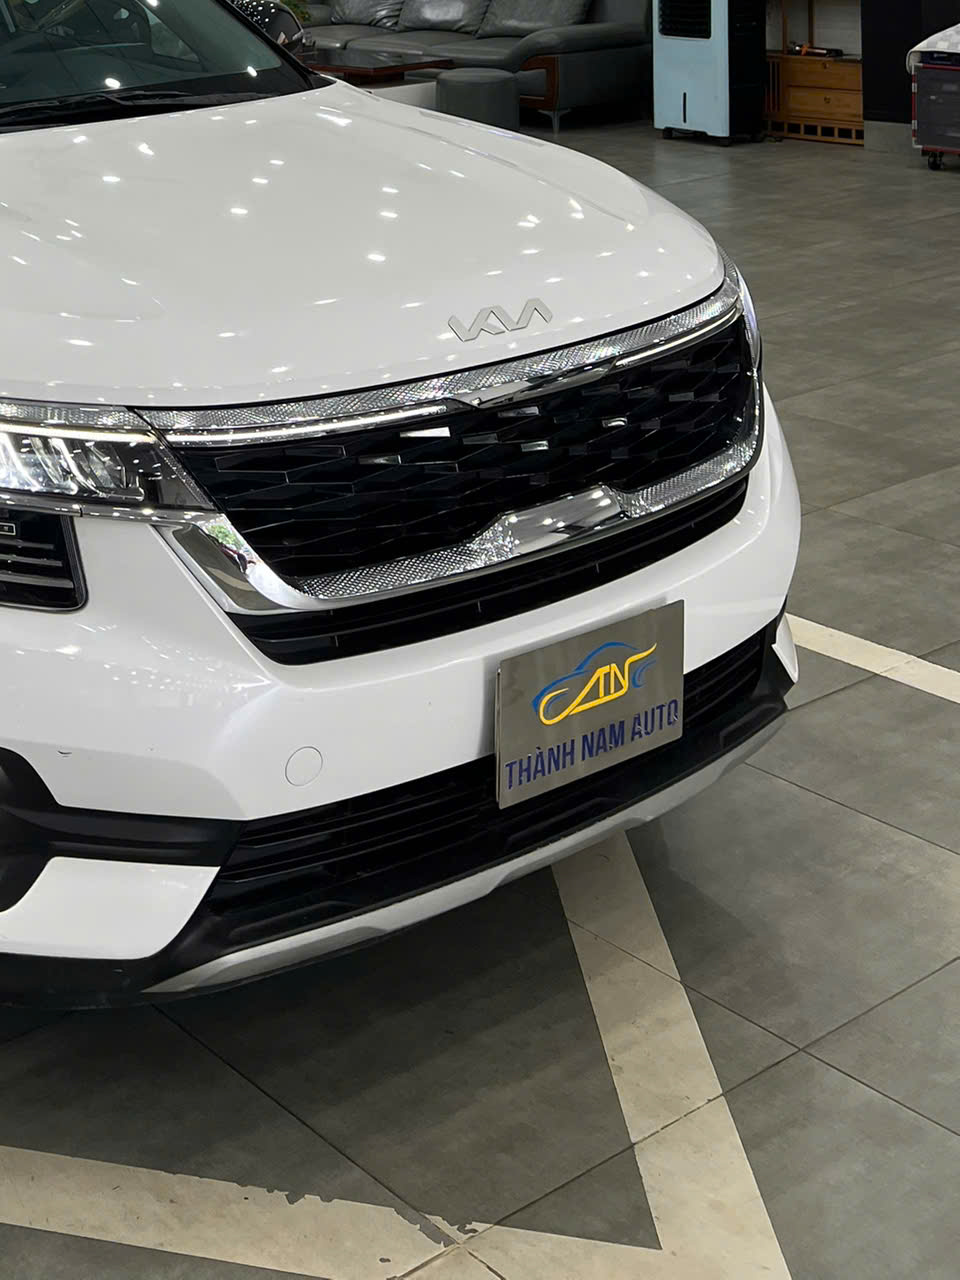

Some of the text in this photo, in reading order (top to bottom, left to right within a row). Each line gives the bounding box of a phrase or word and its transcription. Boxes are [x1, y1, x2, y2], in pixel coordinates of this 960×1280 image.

[504, 699, 679, 790] THÀNH NAM AUTO
